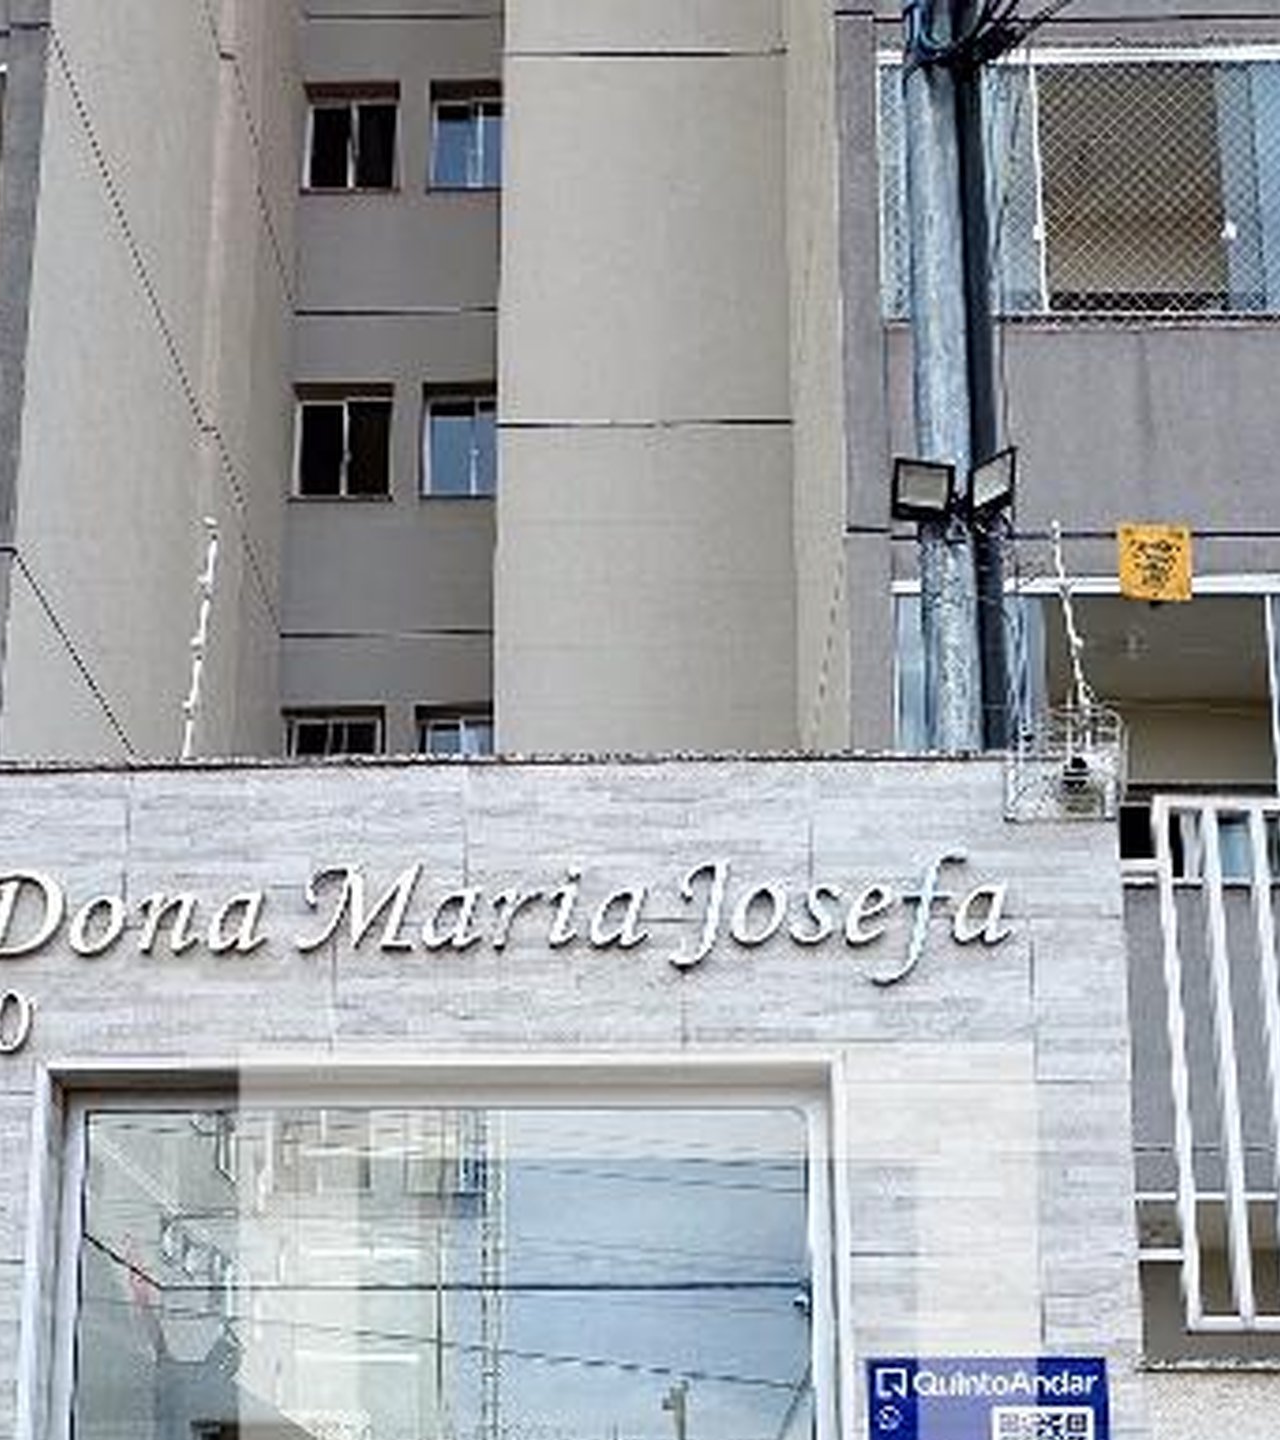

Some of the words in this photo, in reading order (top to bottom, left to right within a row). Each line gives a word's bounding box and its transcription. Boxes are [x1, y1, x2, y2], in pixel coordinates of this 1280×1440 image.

[296, 860, 650, 952] Maria
[669, 849, 1014, 987] Josefa
[912, 1371, 1099, 1397] QuintoAndar
